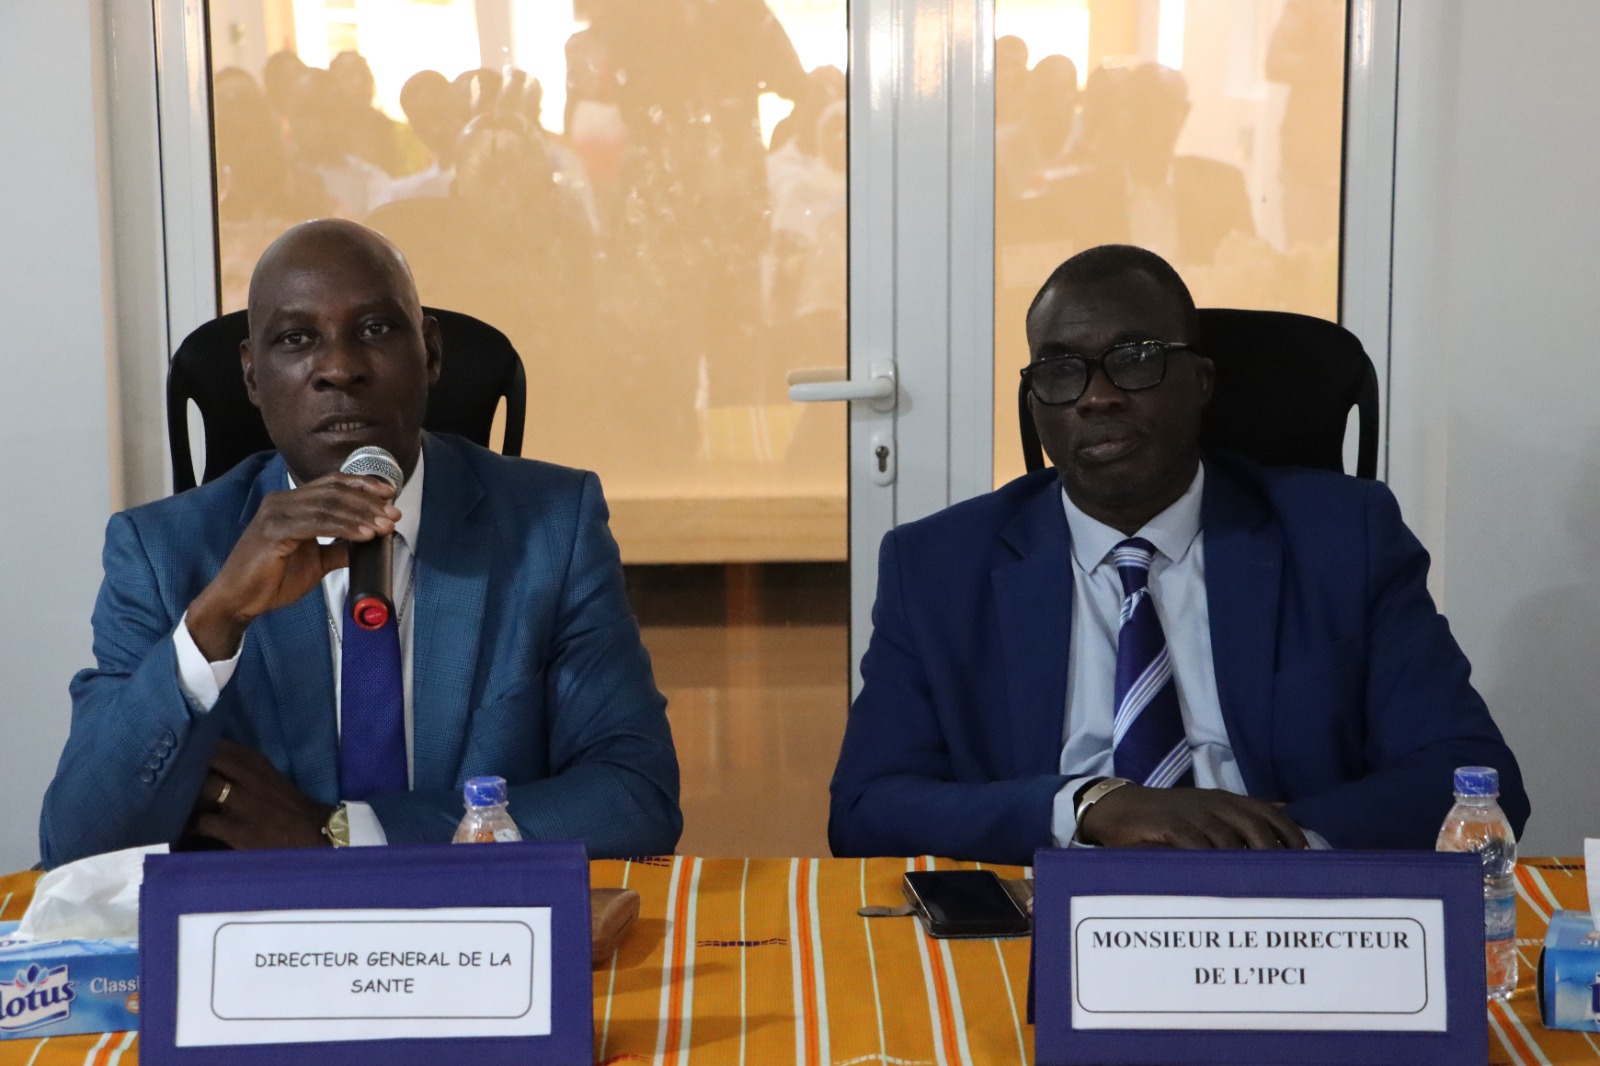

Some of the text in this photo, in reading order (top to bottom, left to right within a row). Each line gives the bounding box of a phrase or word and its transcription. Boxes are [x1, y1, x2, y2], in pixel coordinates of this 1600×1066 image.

[1091, 930, 1411, 949] MONSIEUR LE DIRECTEUR
[254, 951, 513, 968] DIRECTEUR GENERAL DE LA
[1194, 967, 1308, 985] DE L’IPCI
[350, 977, 416, 994] SANTE
